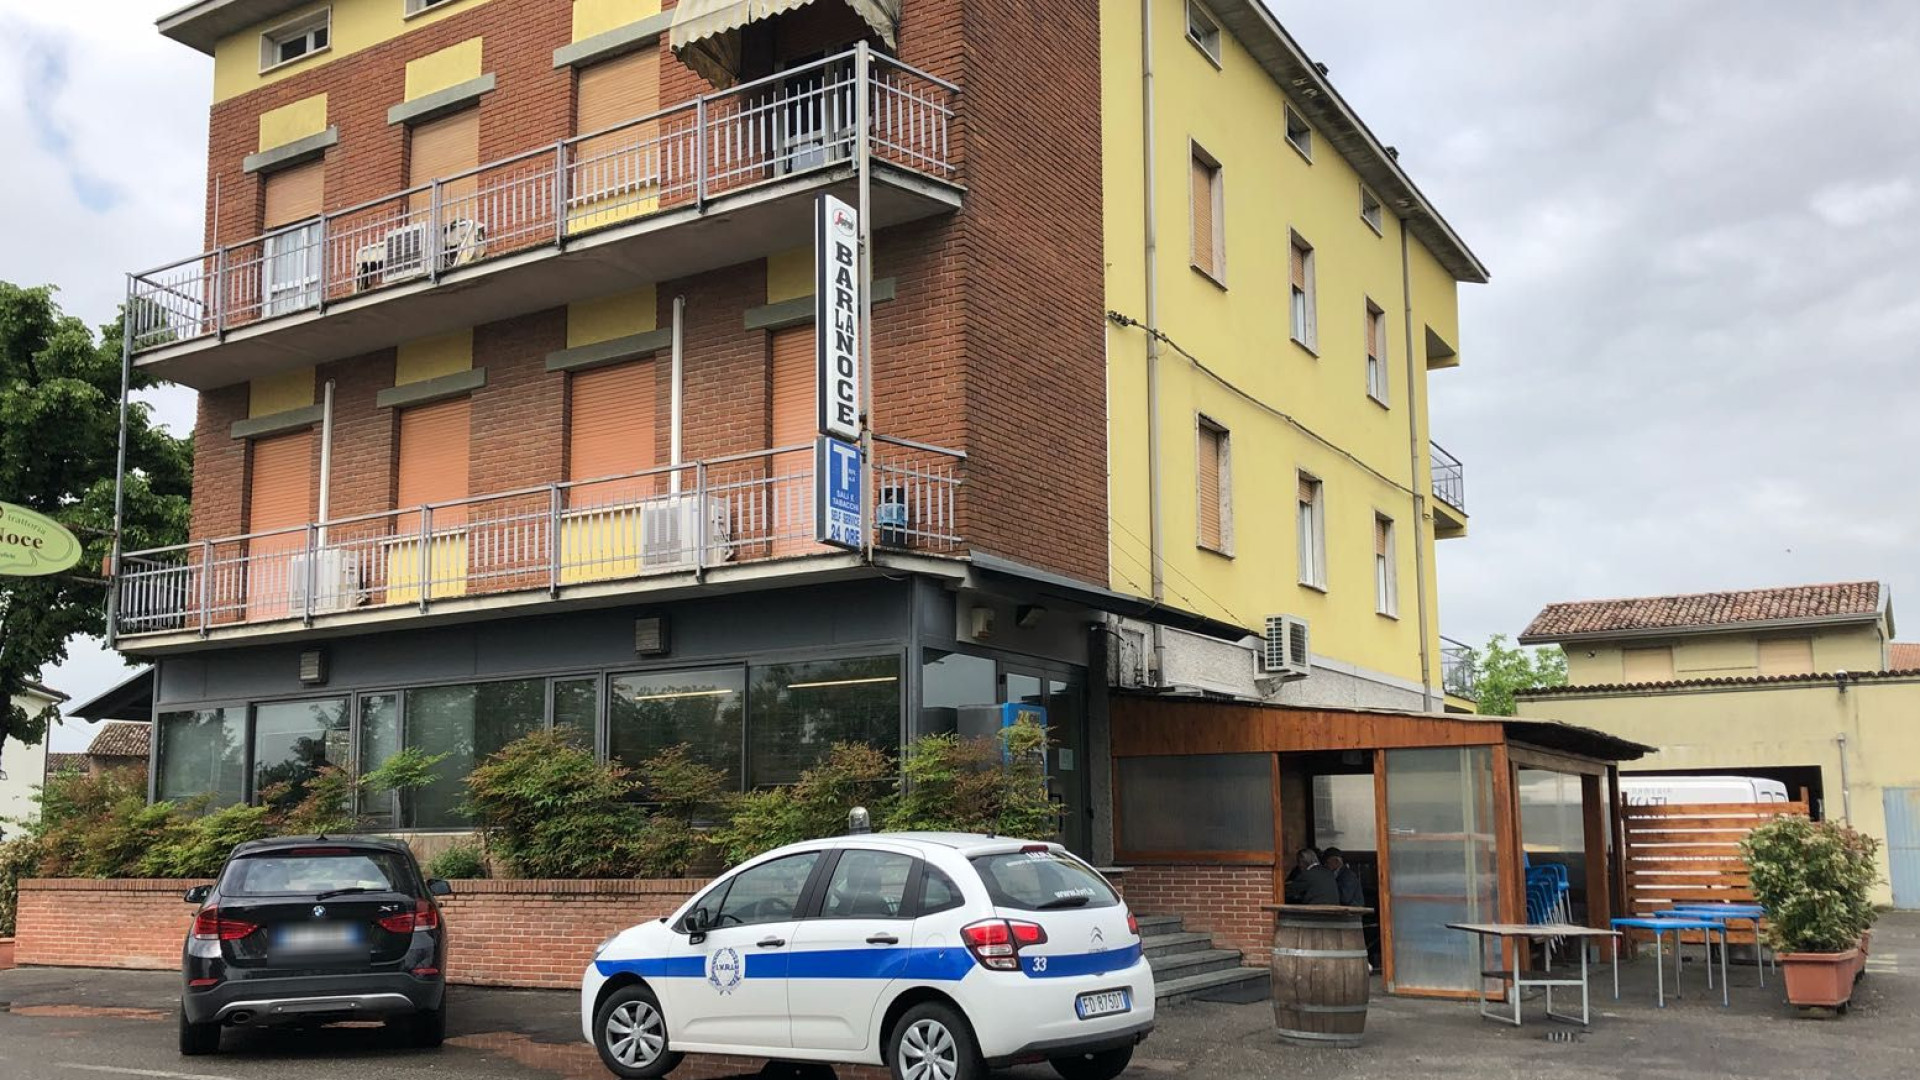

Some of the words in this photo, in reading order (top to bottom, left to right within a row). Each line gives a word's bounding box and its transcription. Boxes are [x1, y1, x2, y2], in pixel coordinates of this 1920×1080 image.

[836, 241, 853, 313] BAR
[836, 330, 855, 427] NOCE
[833, 444, 856, 491] T
[832, 498, 859, 511] TABACCHI
[0, 528, 43, 549] oce
[831, 523, 841, 541] 24
[844, 527, 860, 547] ORE
[1033, 957, 1047, 972] 33
[1082, 996, 1096, 1013] FD
[1097, 992, 1124, 1011] 875DT
